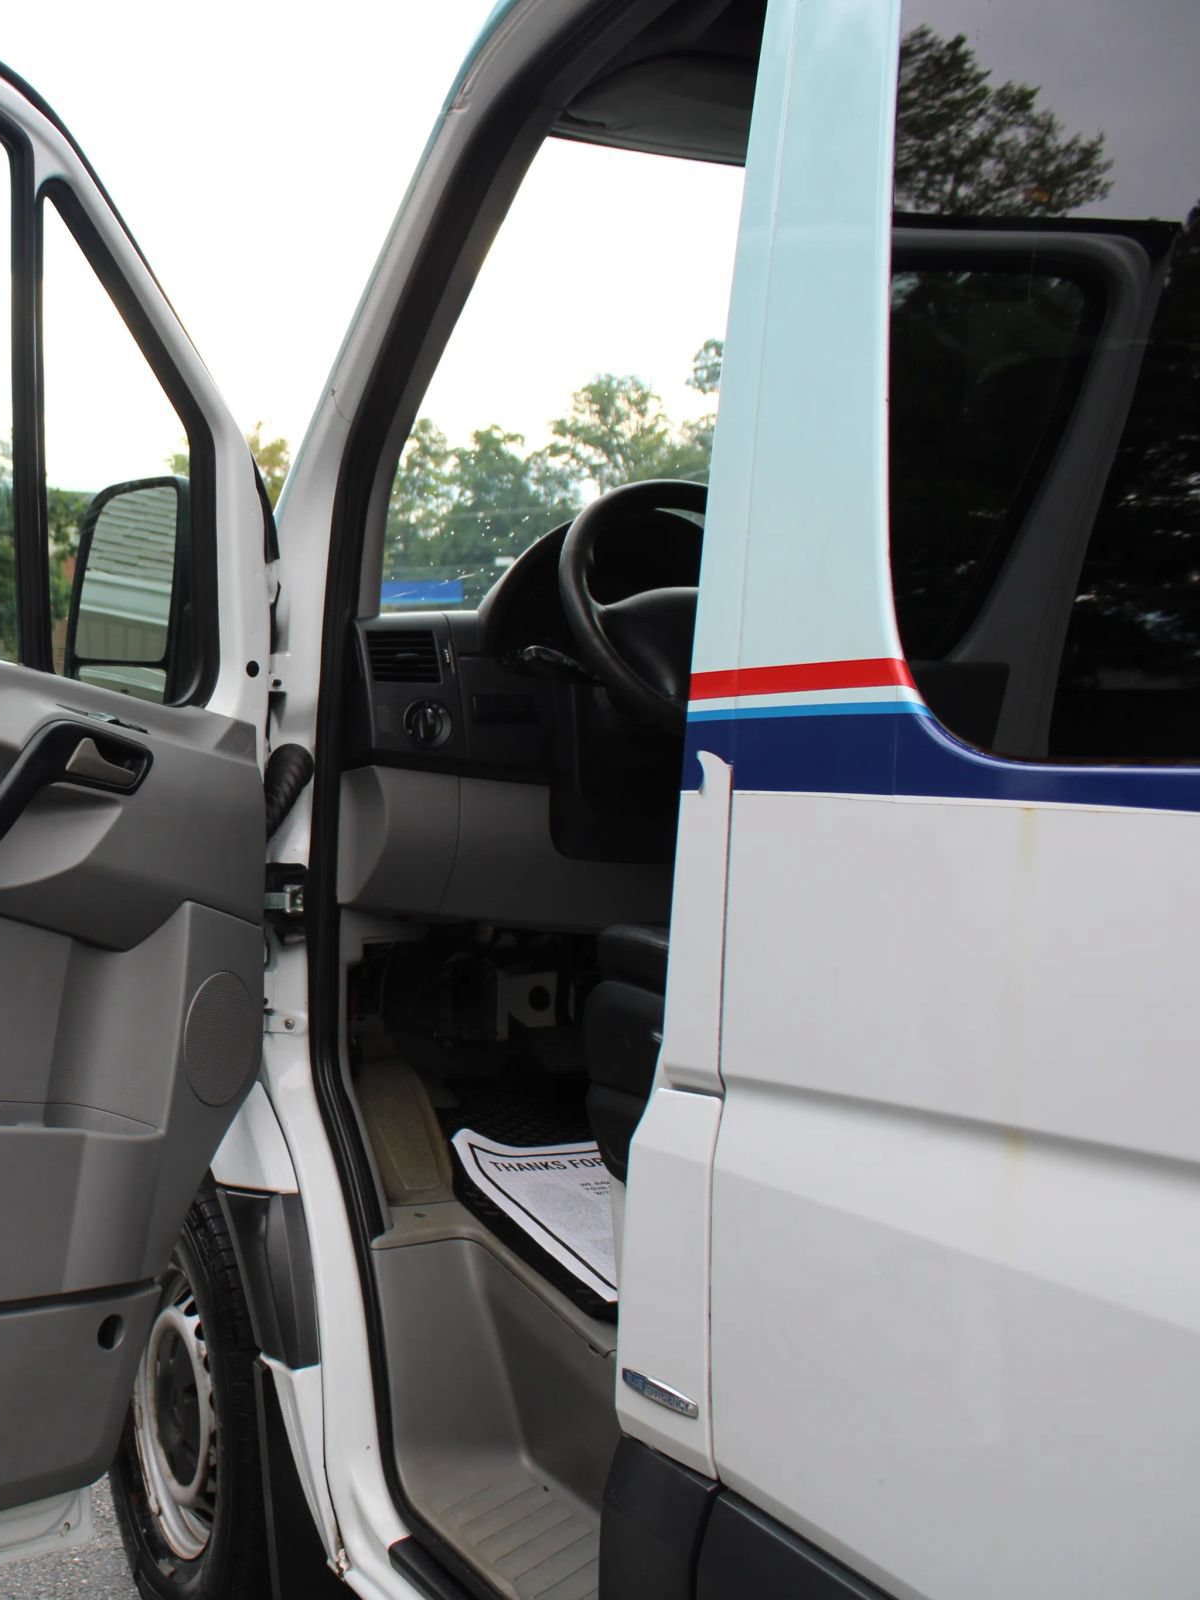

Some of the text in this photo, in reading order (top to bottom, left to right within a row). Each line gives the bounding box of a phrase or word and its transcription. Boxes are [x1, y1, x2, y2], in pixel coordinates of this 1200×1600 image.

[489, 1160, 567, 1172] THANKS
[625, 1371, 690, 1412] BLUE EFFICIENCY
